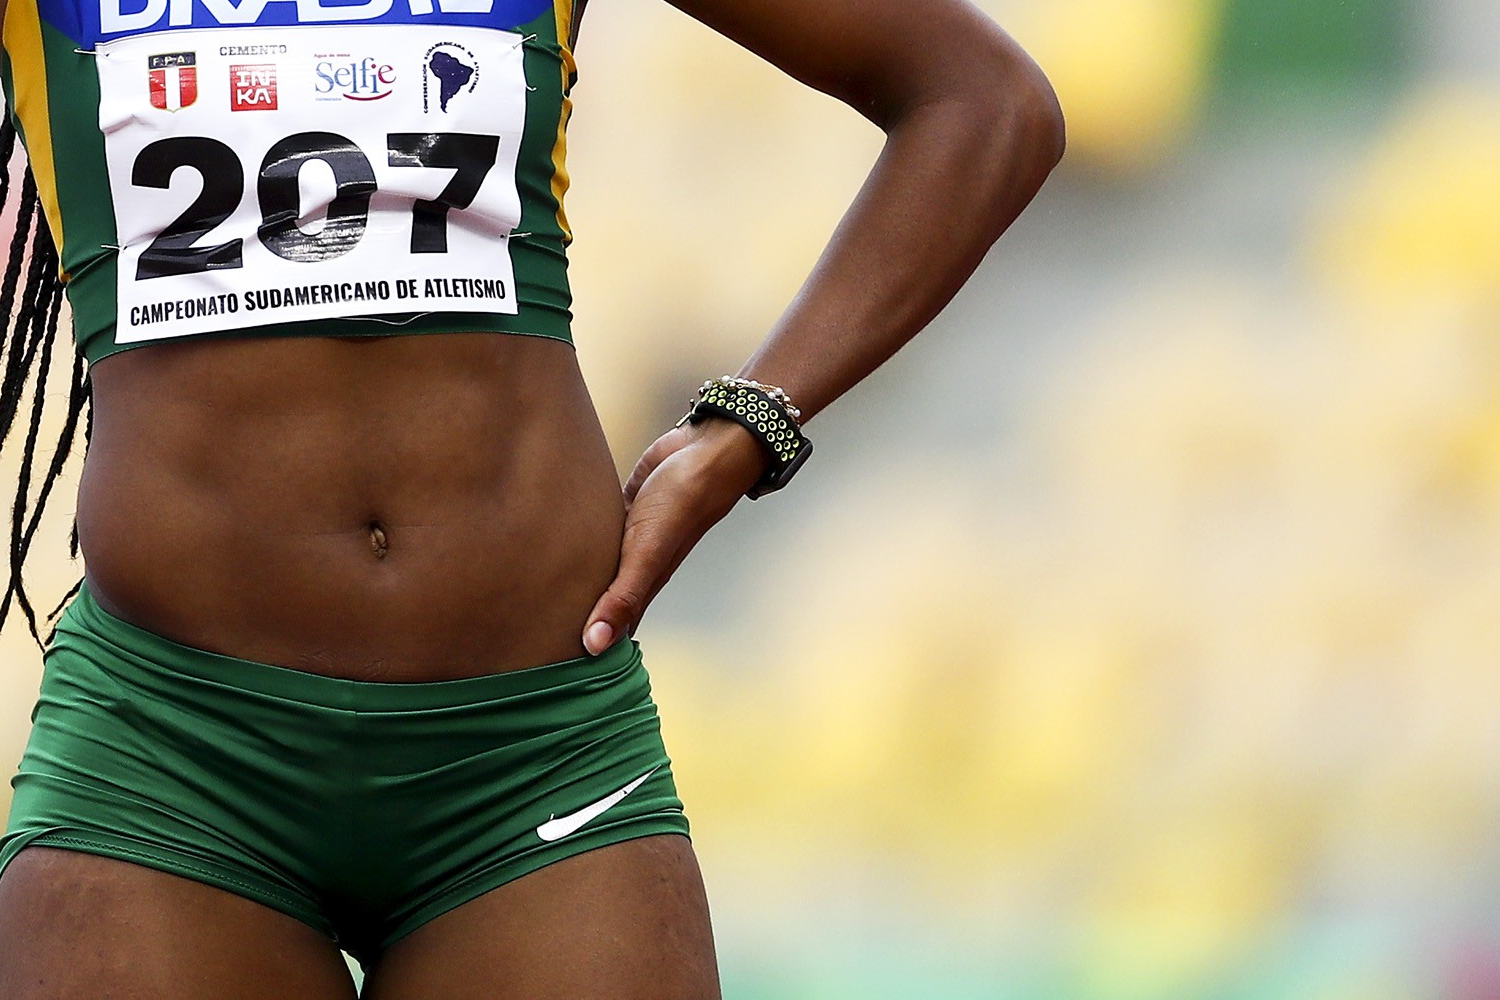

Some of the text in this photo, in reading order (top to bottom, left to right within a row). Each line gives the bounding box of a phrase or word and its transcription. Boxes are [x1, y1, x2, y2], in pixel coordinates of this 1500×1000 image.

[218, 44, 287, 56] CEMENTO
[315, 57, 397, 94] Selfie
[236, 88, 272, 105] KA
[131, 131, 501, 281] 207
[130, 278, 506, 327] CAMPEONATO SUDAMERICANO DE ATLETISMO
